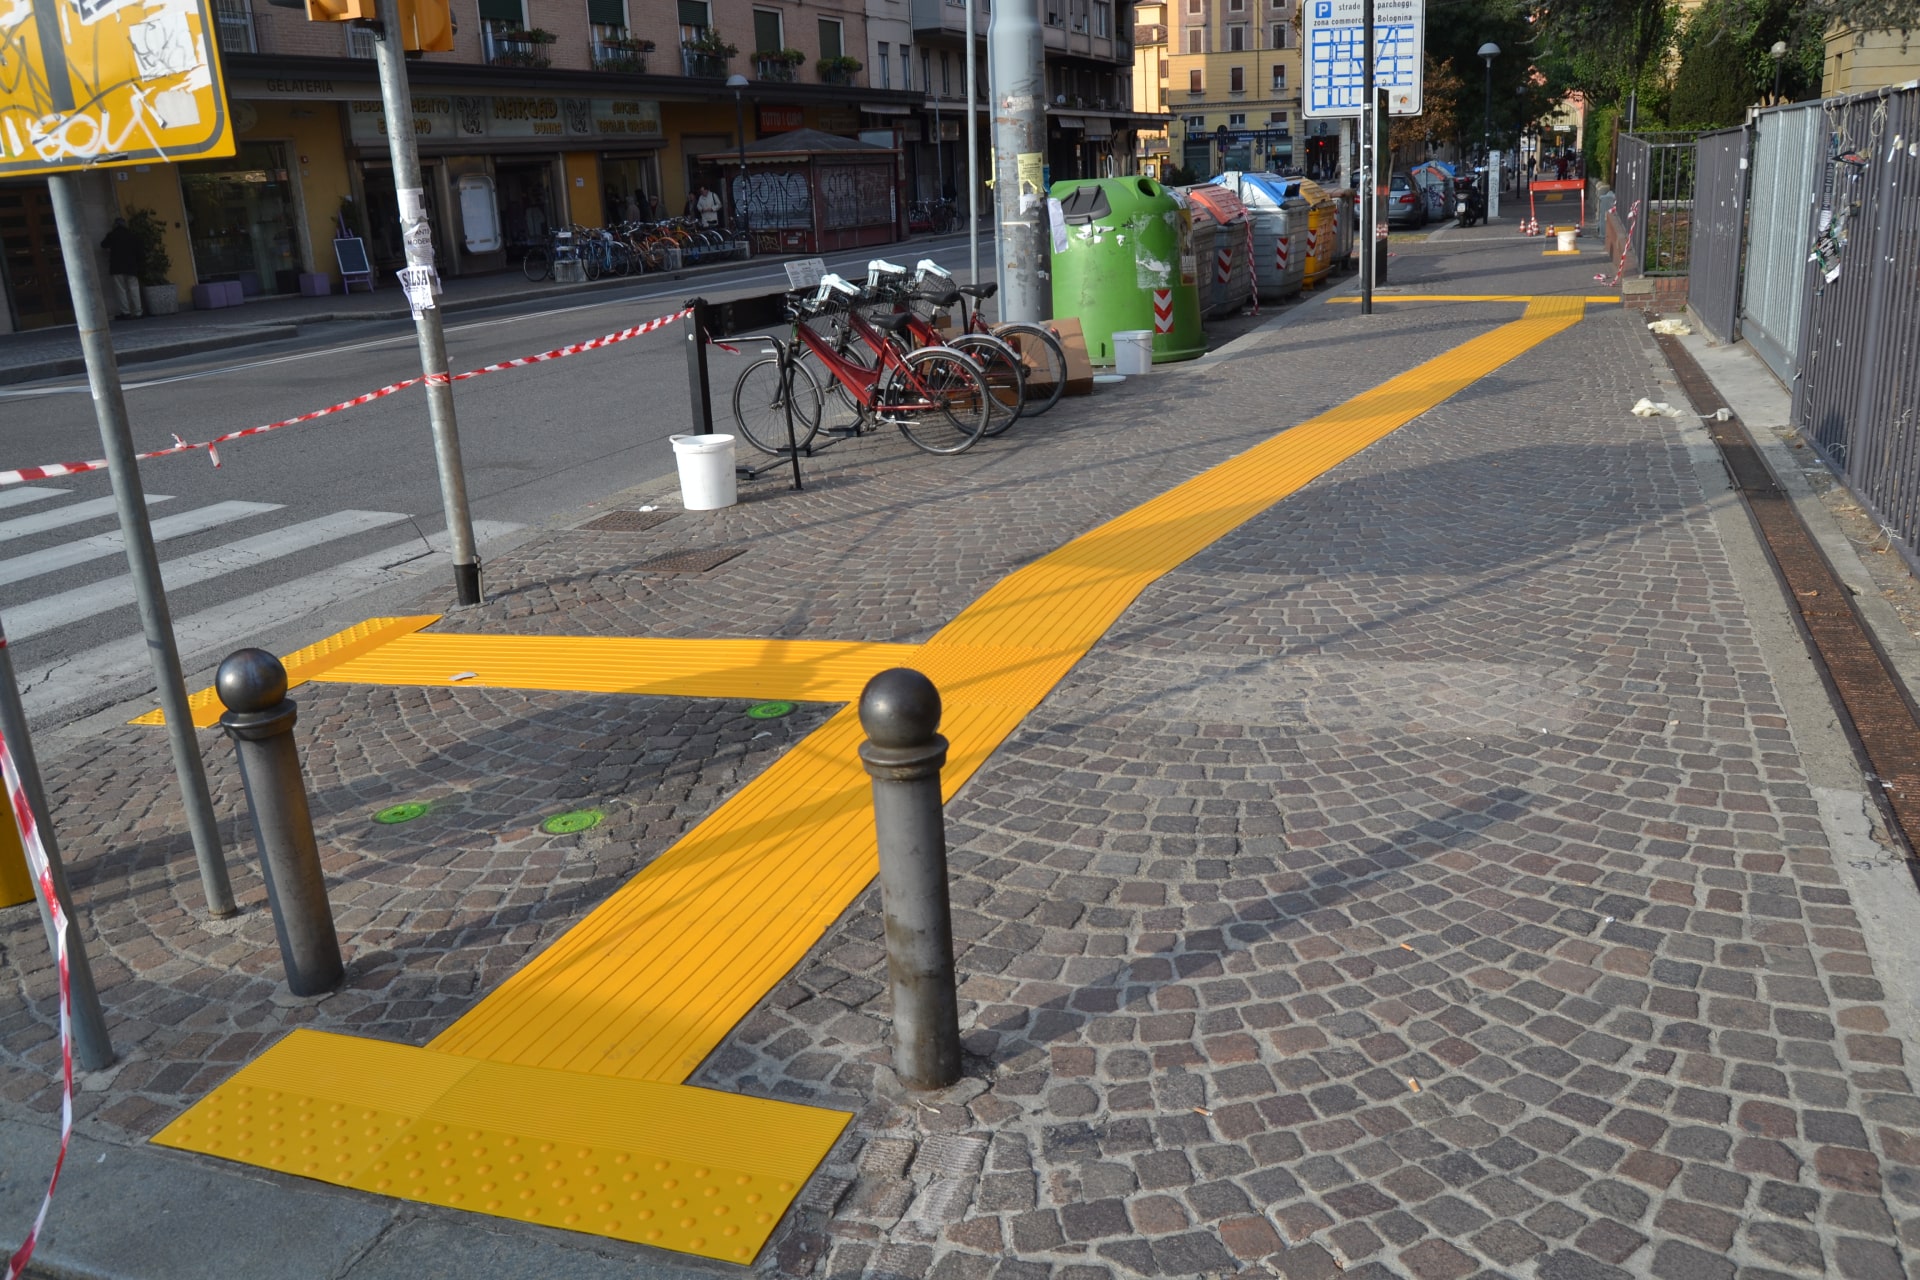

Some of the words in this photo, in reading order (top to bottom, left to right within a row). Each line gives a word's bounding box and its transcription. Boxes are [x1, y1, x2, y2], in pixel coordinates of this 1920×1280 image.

[1318, 4, 1329, 17] P
[1338, 3, 1361, 11] strade
[1377, 1, 1412, 10] parcheggi
[1331, 17, 1365, 25] commerc
[1377, 14, 1413, 23] Bolognina
[267, 80, 335, 93] GELATERIA
[612, 101, 640, 115] ANCHE
